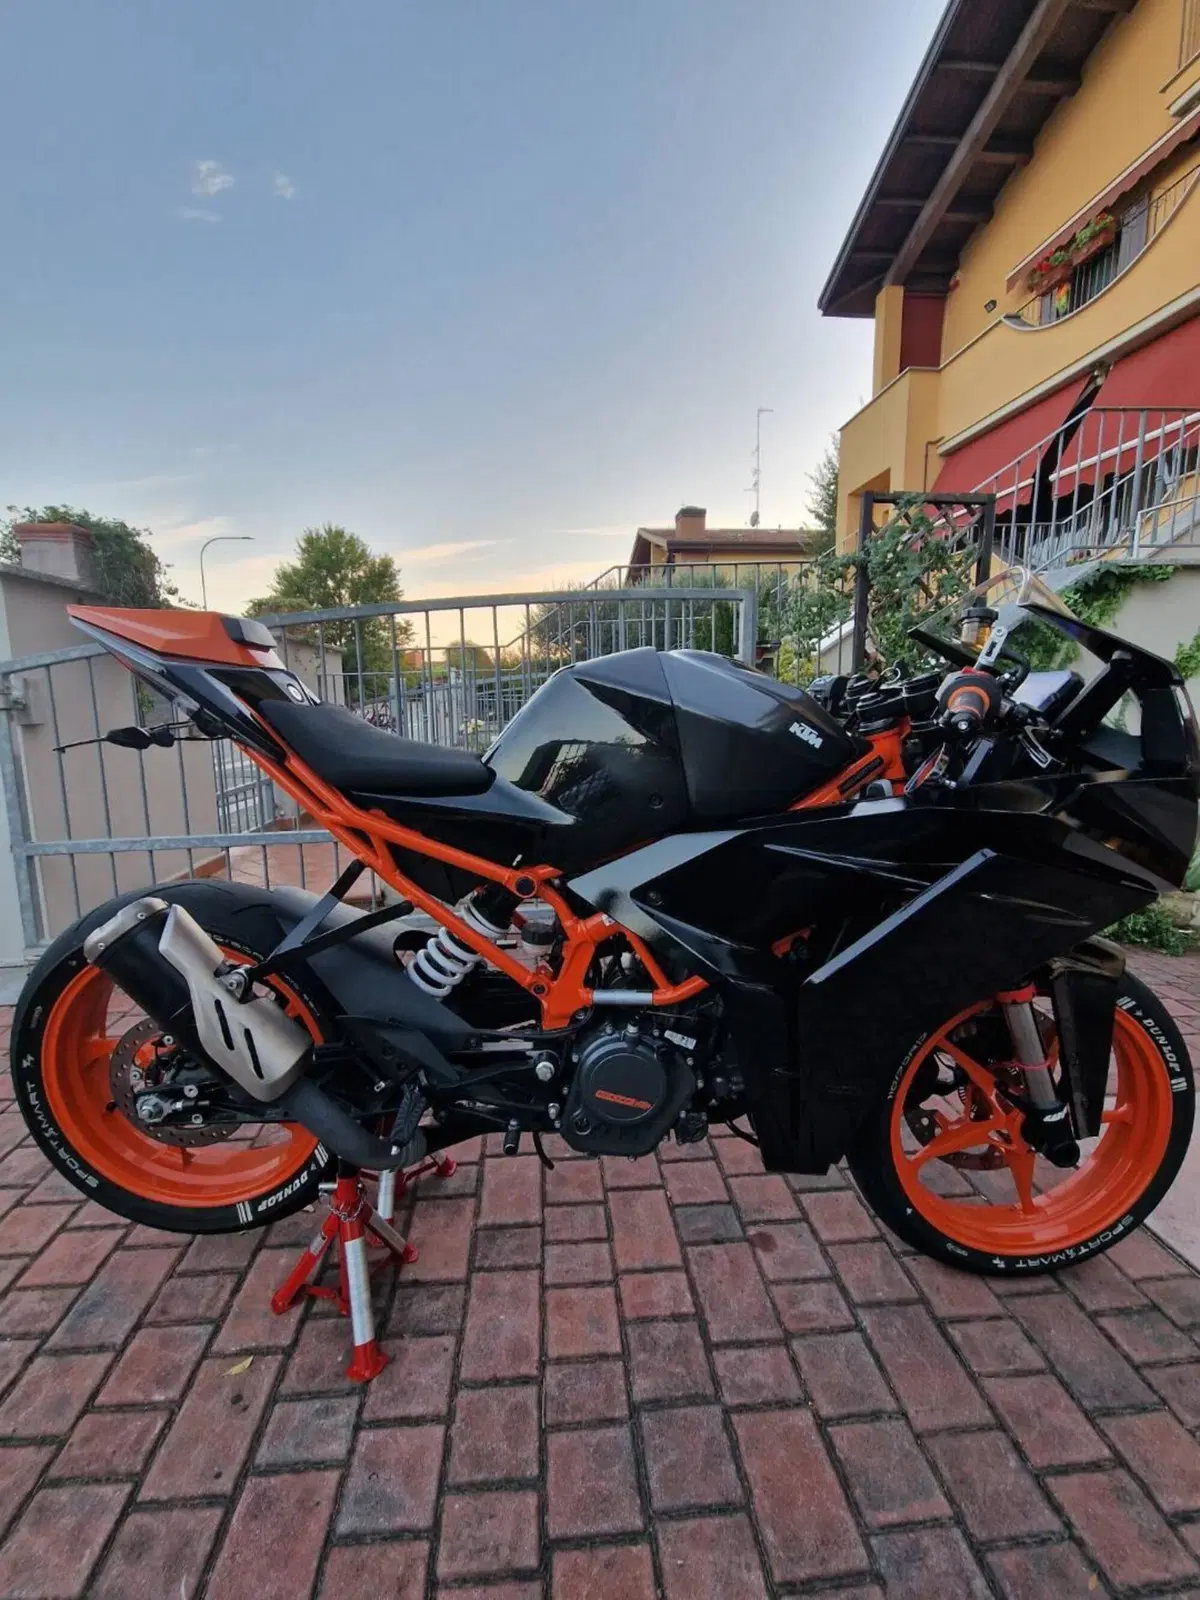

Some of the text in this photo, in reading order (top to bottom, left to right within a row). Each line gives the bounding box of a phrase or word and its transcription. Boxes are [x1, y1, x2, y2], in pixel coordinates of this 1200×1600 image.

[789, 721, 823, 749] KTM
[1142, 1018, 1181, 1072] DUNLOP
[257, 1170, 308, 1212] DUNLOP
